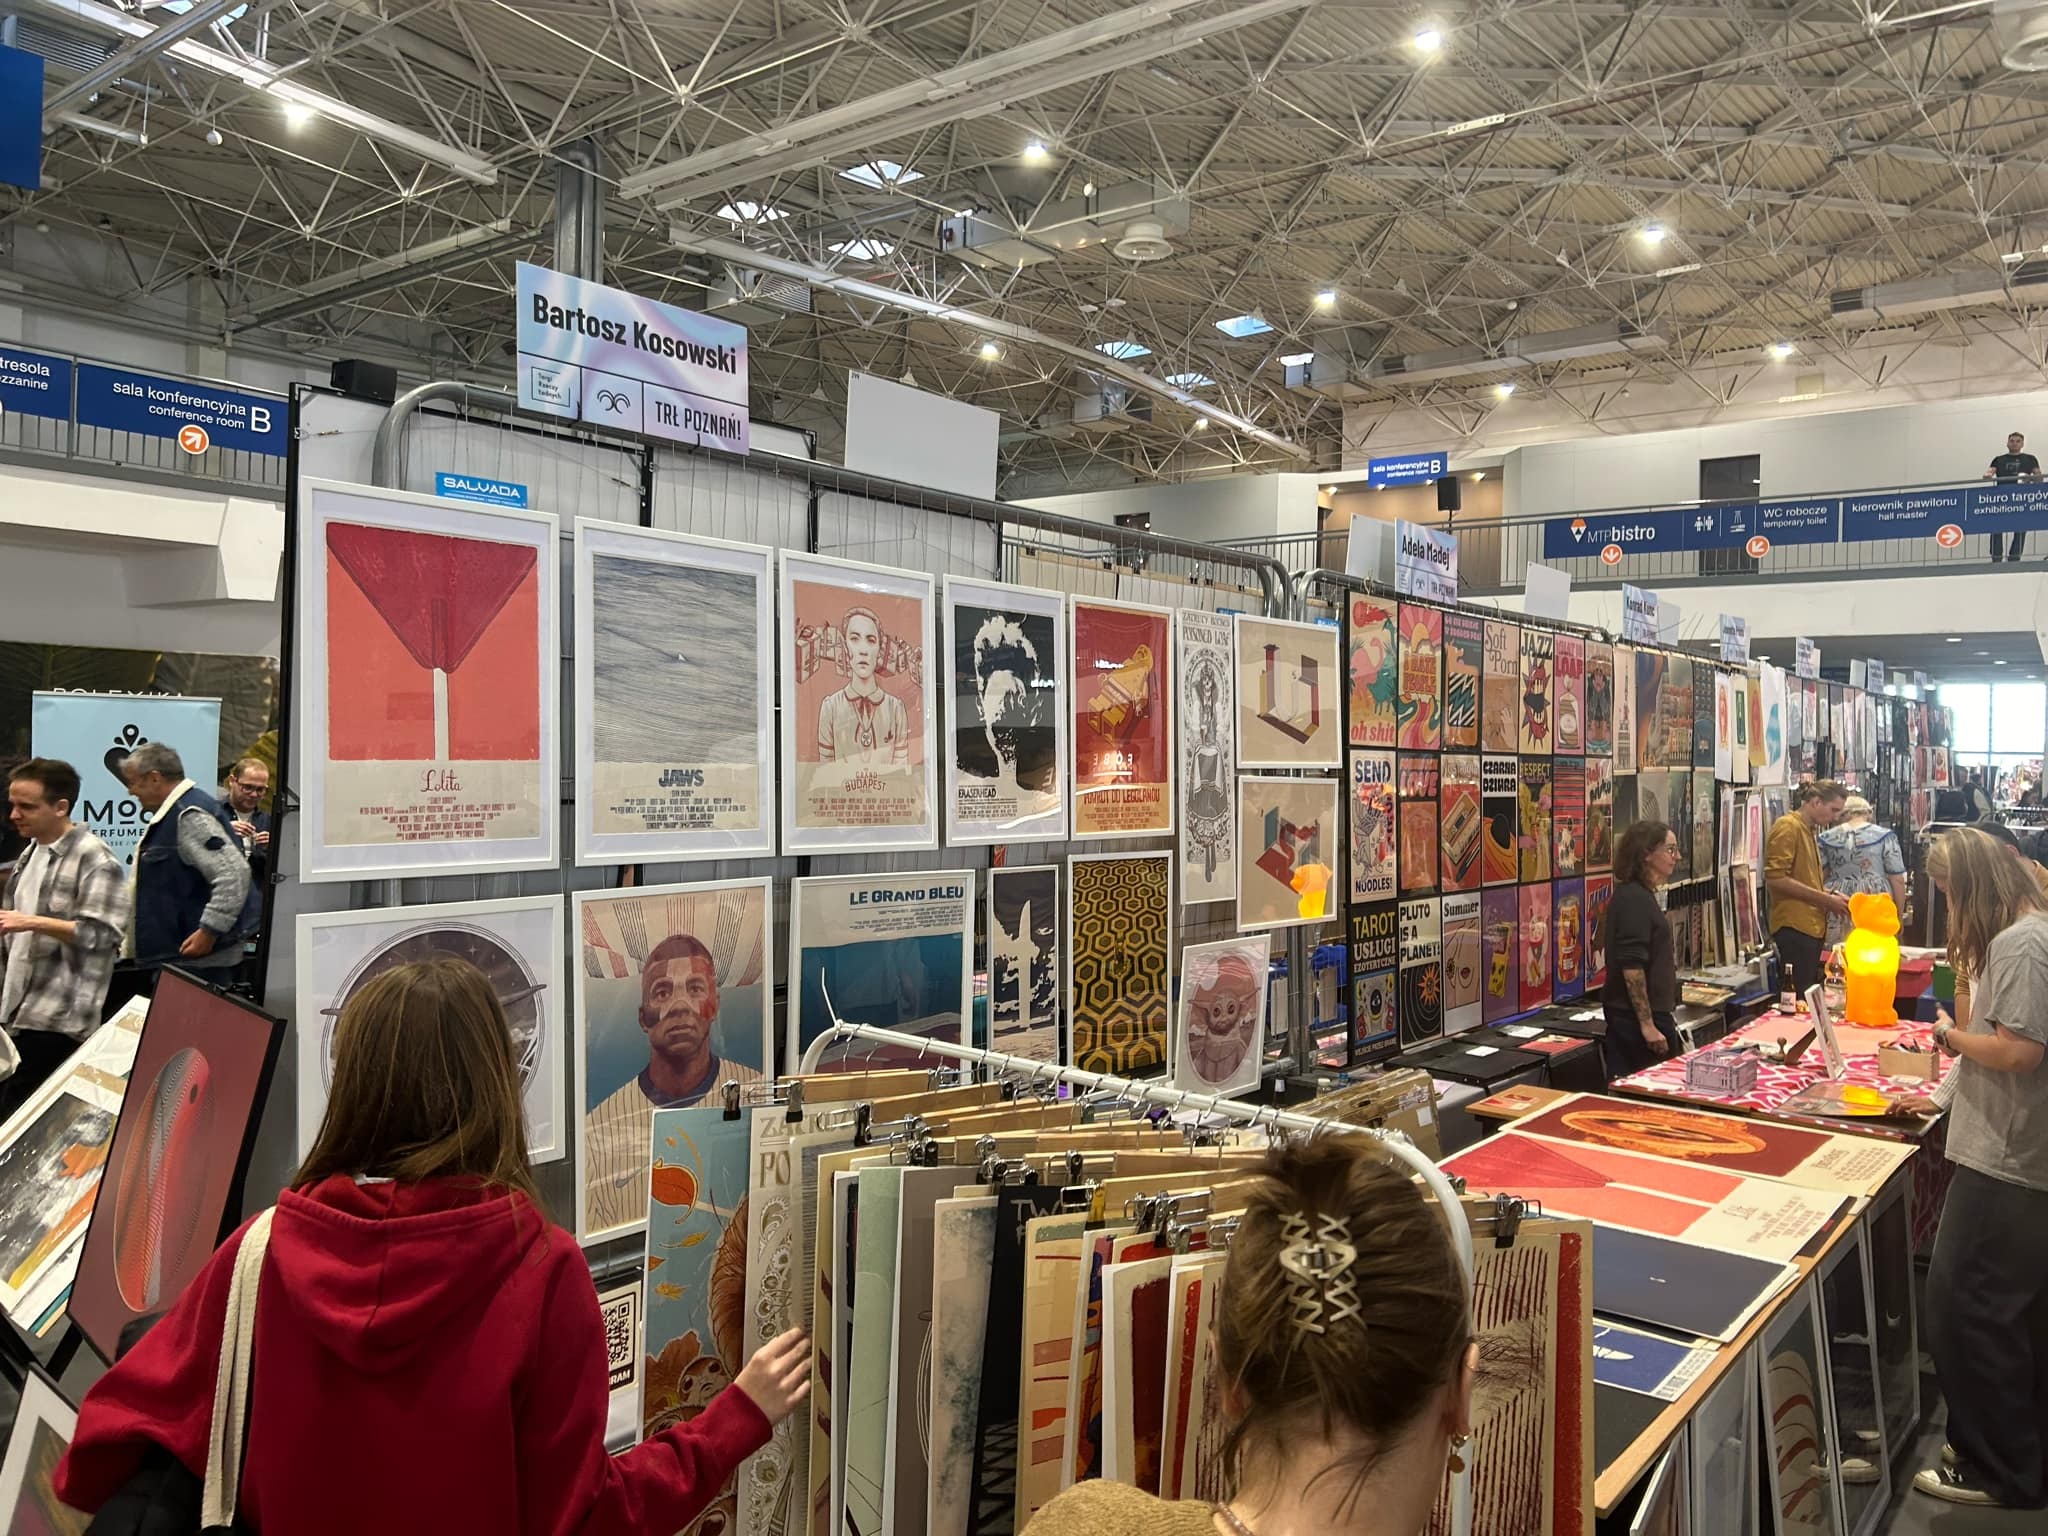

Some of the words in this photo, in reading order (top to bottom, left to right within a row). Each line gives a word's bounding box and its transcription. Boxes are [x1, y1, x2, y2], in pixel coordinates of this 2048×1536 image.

[533, 293, 627, 346] Bartosz
[633, 321, 737, 375] Kosowski
[0, 374, 49, 391] zzanine
[113, 381, 143, 398] sala
[148, 385, 246, 416] konferencyjna
[149, 403, 214, 425] conference
[216, 415, 245, 429] room
[250, 406, 272, 434] B
[655, 401, 680, 427] TRŁ
[684, 407, 741, 441] POZNAŃ!
[1430, 459, 1441, 474] B
[443, 477, 521, 498] SALVADA
[1852, 500, 1904, 513] kierownik
[1906, 496, 1958, 510] pawilonu
[1978, 492, 2009, 504] biuro
[1763, 507, 1783, 519] WC
[1785, 505, 1828, 517] robocze
[1878, 512, 1895, 521] hall
[1896, 510, 1929, 520] master
[1974, 504, 2027, 515] exhibitions'
[1763, 518, 1804, 530] temporary
[1806, 516, 1828, 526] toilet
[1402, 535, 1425, 560] Adela
[1426, 542, 1450, 571] Madej
[1485, 624, 1507, 652] Soft
[1521, 632, 1553, 660] JAZZ
[1489, 650, 1518, 675] Porn
[1350, 720, 1367, 741] oh
[1369, 722, 1395, 742] shit
[1355, 760, 1391, 783] SEND
[1482, 761, 1516, 775] CZARNA
[420, 769, 463, 793] Lolita
[658, 769, 704, 787] JAWS
[845, 778, 887, 792] BUDAPEST
[1482, 778, 1516, 793] DZIURA
[958, 788, 997, 799] ERASERHEAD
[91, 828, 145, 838] ERFUME
[1355, 877, 1393, 893] NOODLES!
[849, 890, 868, 905] LE
[872, 889, 926, 903] GRAND
[929, 886, 964, 900] BLEU
[1399, 903, 1431, 922] PLUTO
[1443, 901, 1480, 917] Summer
[1353, 911, 1396, 940] TAROT
[1400, 926, 1409, 942] IS
[1411, 925, 1418, 940] A
[1353, 937, 1396, 961] USŁUGI
[1400, 941, 1441, 962] PLANET!
[609, 1369, 631, 1385] RAM
